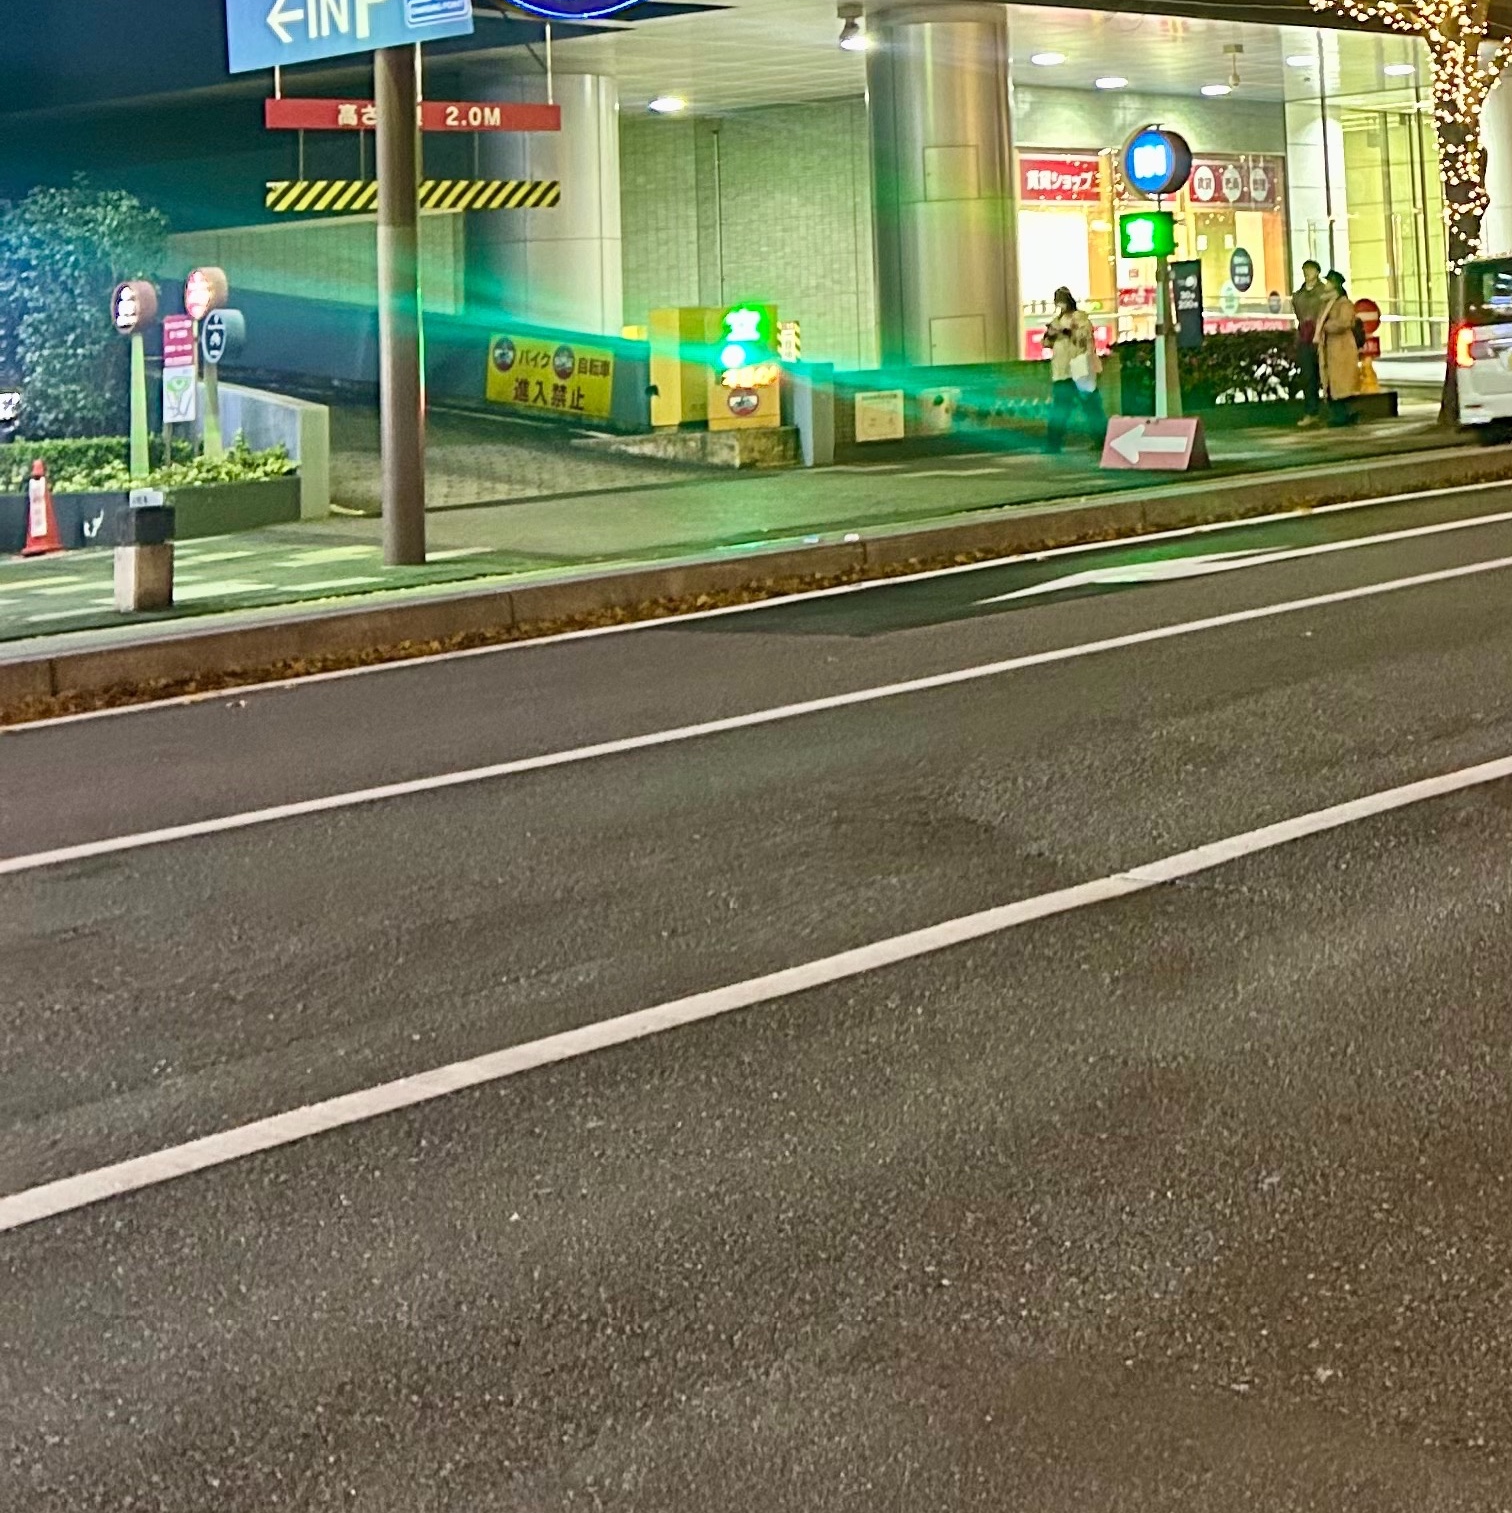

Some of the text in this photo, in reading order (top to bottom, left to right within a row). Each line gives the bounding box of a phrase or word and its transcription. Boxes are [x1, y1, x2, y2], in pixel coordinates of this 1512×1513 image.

[445, 106, 500, 126] 2.0M
[518, 348, 551, 369] バイク
[513, 377, 585, 411] 進入禁止
